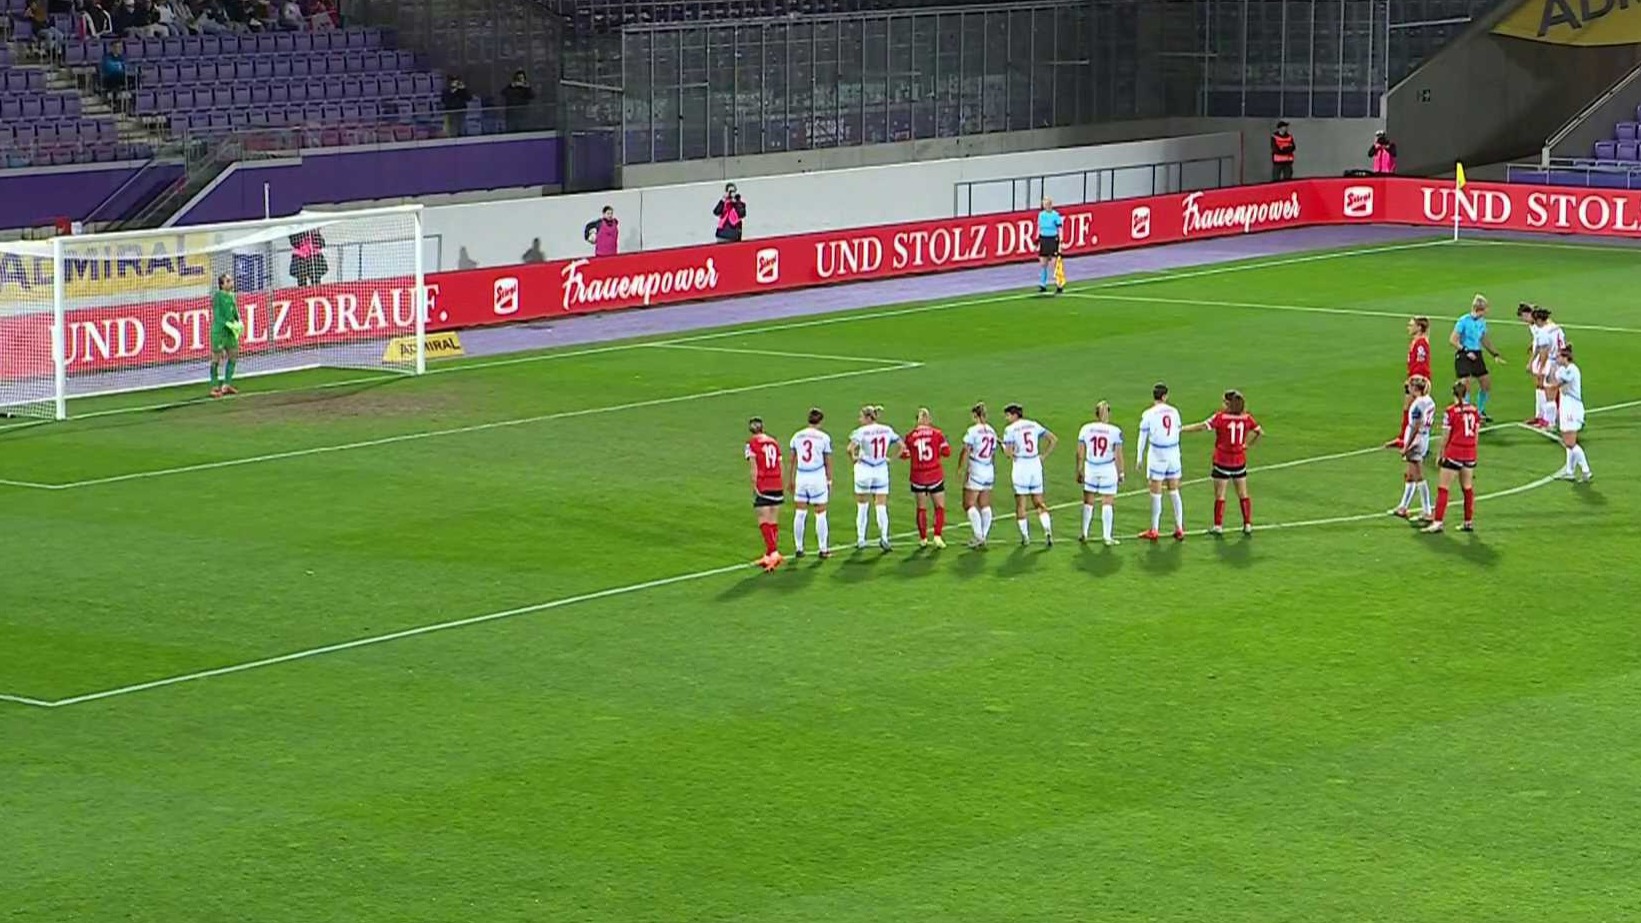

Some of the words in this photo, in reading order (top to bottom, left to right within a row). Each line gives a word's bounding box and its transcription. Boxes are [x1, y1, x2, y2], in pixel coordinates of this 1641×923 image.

[1537, 0, 1641, 37] AD
[1182, 191, 1302, 236] Frauenpower
[1421, 187, 1512, 223] UND
[1526, 191, 1641, 231] STOL
[815, 236, 883, 278] UND
[892, 223, 988, 268] STOLZ
[995, 212, 1099, 257] DRUF.
[561, 257, 719, 311] Frauenpower
[50, 316, 145, 366] UND
[160, 300, 292, 354] STLZ
[305, 283, 448, 338] DRAUF.
[1162, 415, 1172, 437] 9
[1227, 420, 1245, 445] 11
[802, 440, 813, 463] 3
[871, 436, 886, 460] 11
[912, 437, 933, 462] 15
[978, 436, 995, 459] 21
[1023, 431, 1034, 453] 5
[1089, 436, 1108, 457] 19
[762, 442, 778, 469] 19
